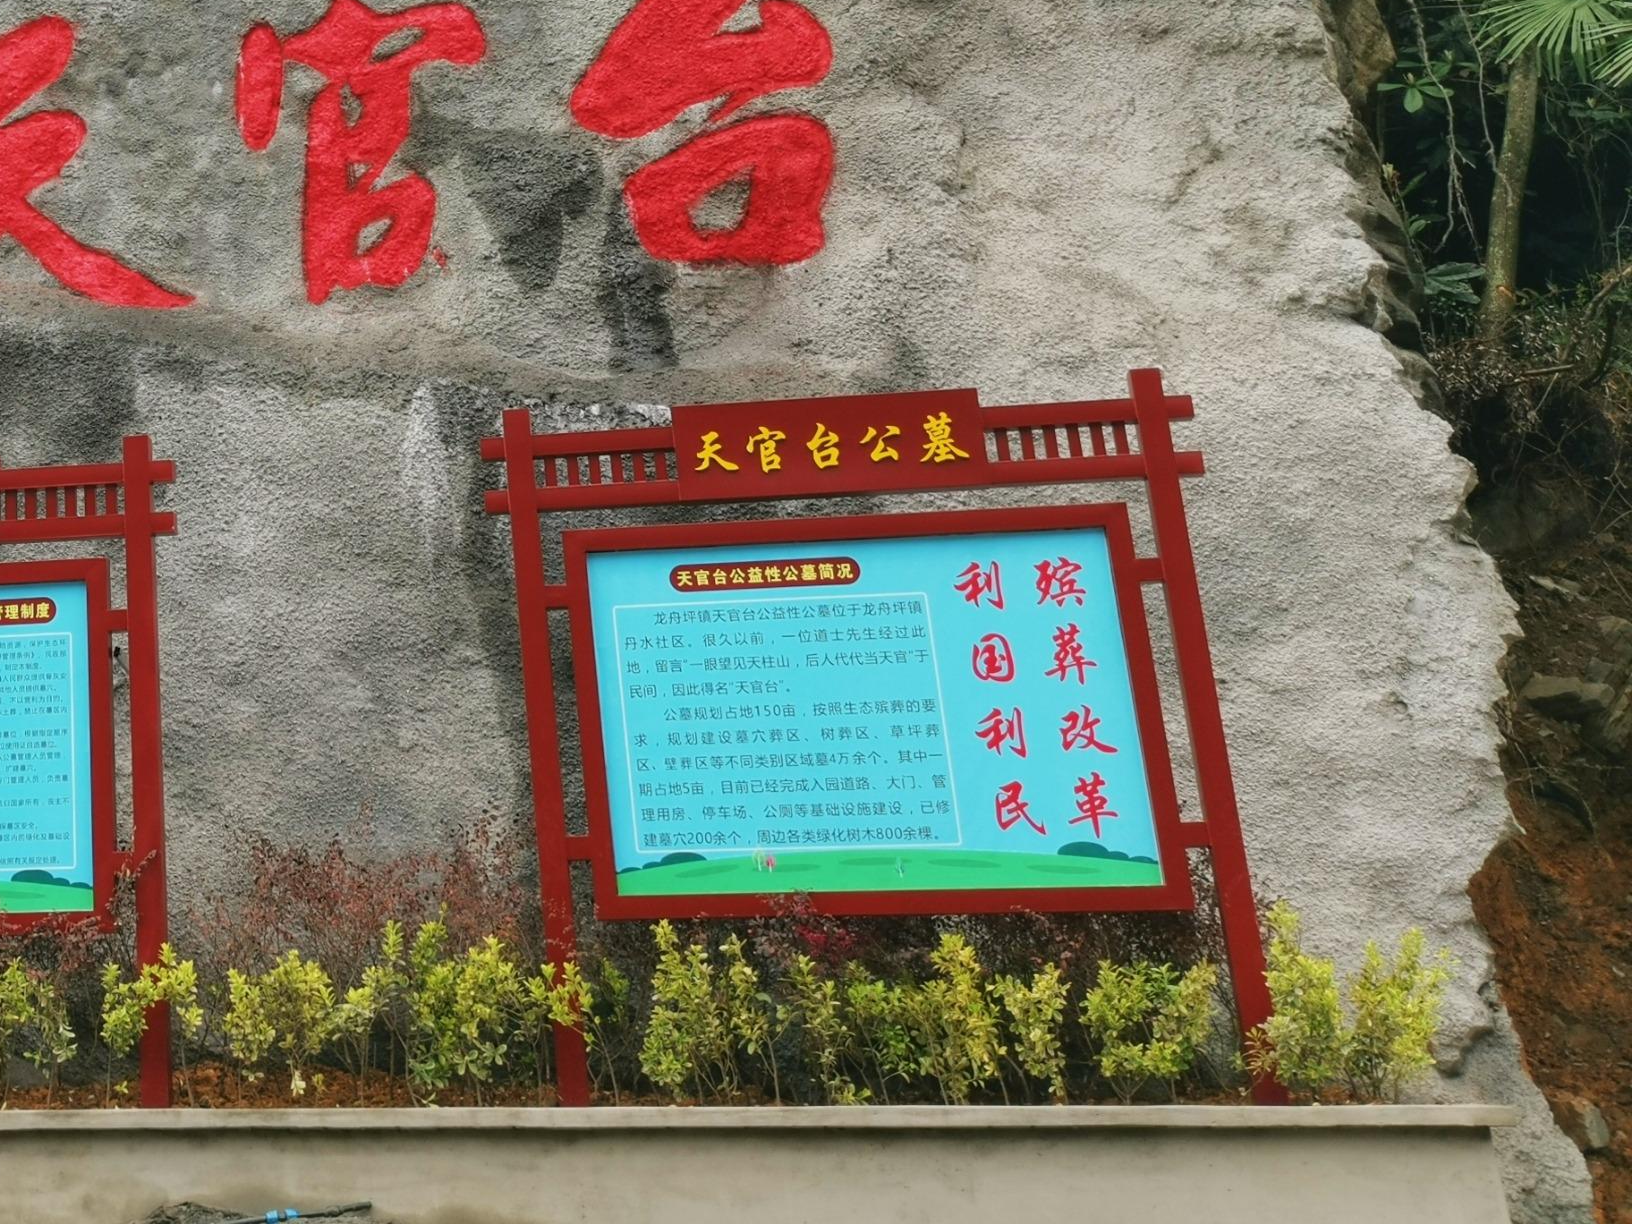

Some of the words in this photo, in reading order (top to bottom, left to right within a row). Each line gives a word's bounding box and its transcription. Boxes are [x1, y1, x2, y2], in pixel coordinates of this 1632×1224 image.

[694, 413, 971, 474] 天官台公墓
[676, 562, 855, 587] 天官台公益性公墓简况
[651, 599, 923, 626] 龙舟坪镇天官台公益性公墓位于龙舟坪镇
[954, 561, 1046, 837] 利国利民
[1034, 559, 1119, 837] 殡葬改革
